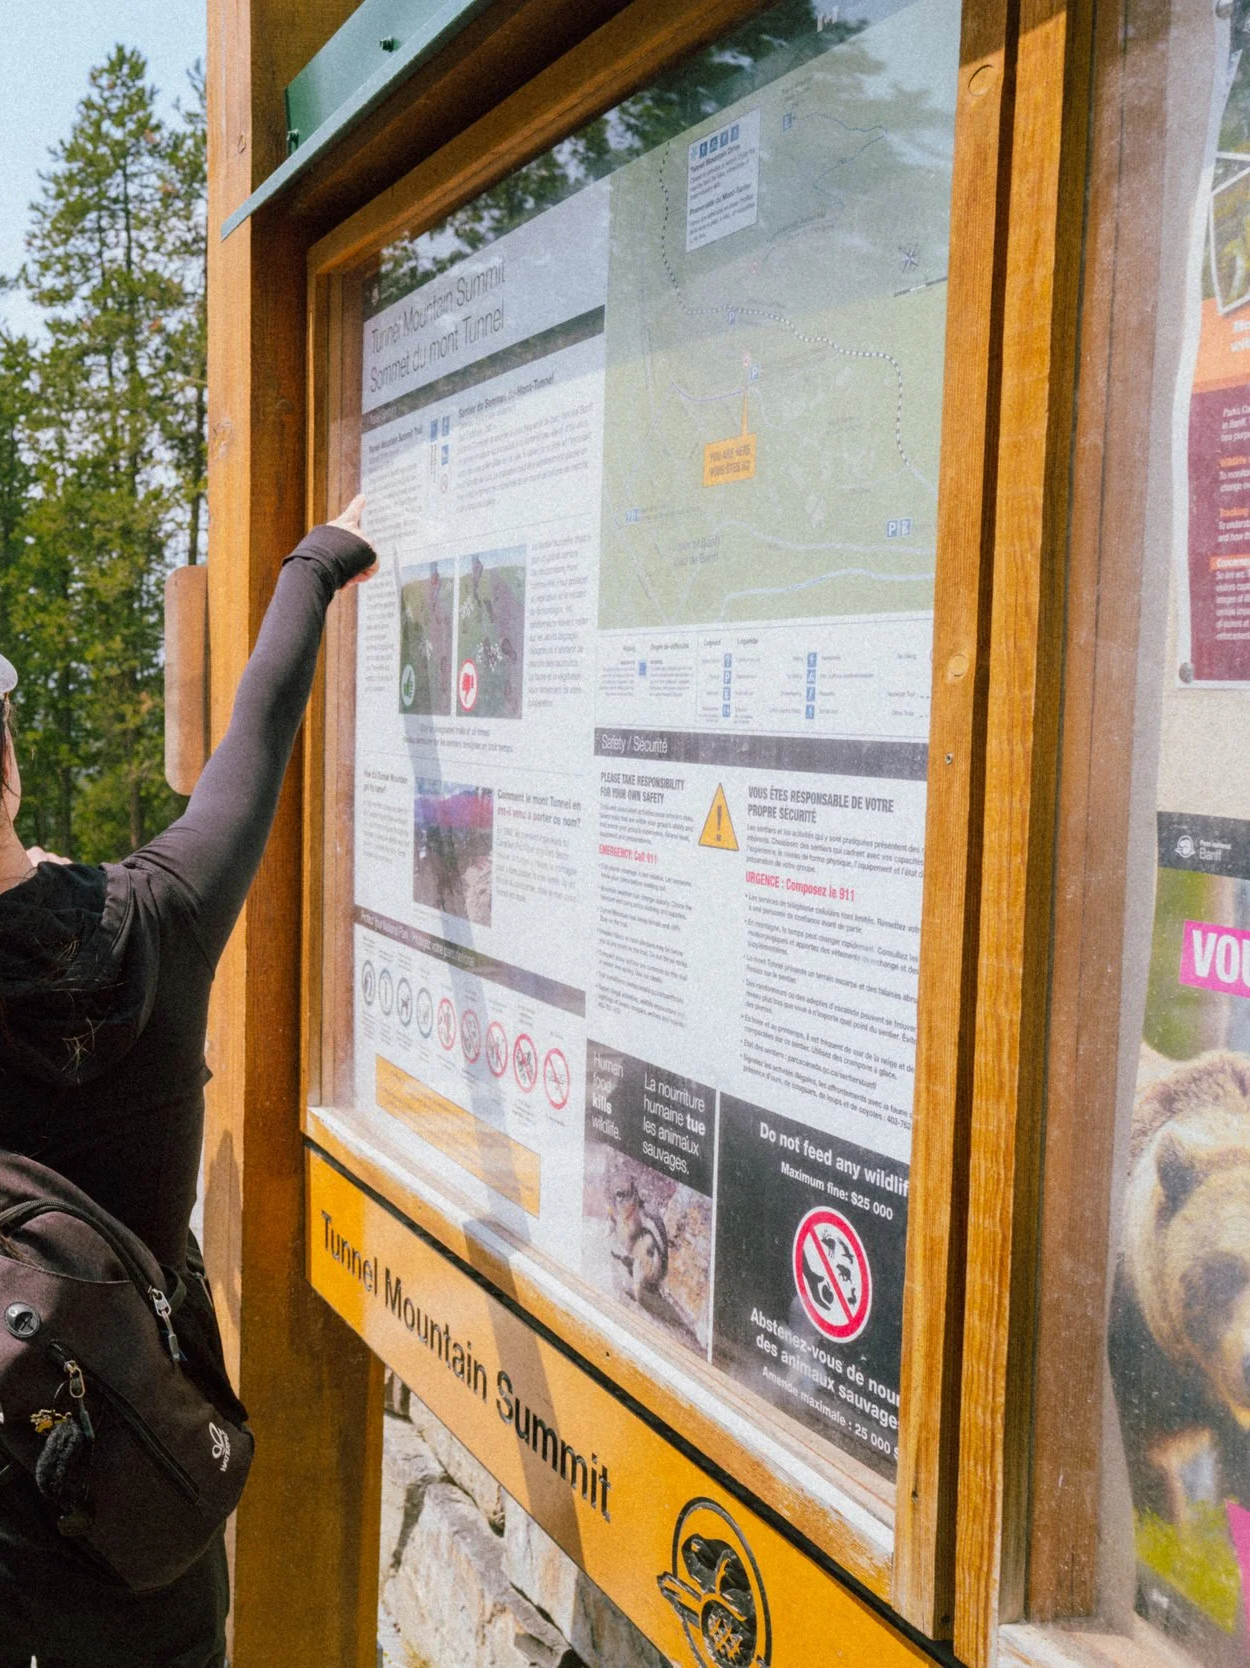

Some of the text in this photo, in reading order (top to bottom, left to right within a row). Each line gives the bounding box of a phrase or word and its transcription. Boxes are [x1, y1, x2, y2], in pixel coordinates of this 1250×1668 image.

[371, 260, 505, 354] Tunnel Mountain Summit
[370, 307, 504, 393] Sommet du mont Tunnel
[601, 734, 668, 754] Safety / Sécurité
[601, 772, 684, 790] PLEASE TAKE RESPONSIBILITY
[498, 789, 581, 811] Comment le mont Tunnel en
[600, 787, 664, 804] FOR YOUR OWN SAFETY
[749, 787, 894, 812] VOUS ÊTES RESPONSABLE DE VOTRE
[533, 812, 551, 823] porter
[553, 816, 561, 825] ce
[563, 817, 581, 828] nom?
[748, 804, 816, 823] PROPRE SÉCURITÉ
[634, 850, 645, 862] Call
[647, 853, 657, 864] 911
[874, 839, 920, 853] présentent des
[1200, 847, 1222, 861] Banff
[746, 872, 779, 888] URGENCE
[786, 878, 826, 898] Composez
[830, 886, 837, 898] le
[839, 887, 855, 901] 911
[877, 918, 906, 930] Remettez
[877, 945, 908, 959] Consultez
[860, 1010, 884, 1025] peuvent
[869, 1024, 877, 1034] du
[593, 1052, 623, 1078] Human
[879, 1067, 897, 1081] glace.
[593, 1074, 615, 1095] food
[644, 1073, 705, 1112] La nourriture
[592, 1092, 612, 1114] kills
[592, 1114, 621, 1141] wildlife.
[643, 1097, 706, 1136] humaine tue
[643, 1116, 699, 1157] les animaux
[642, 1140, 690, 1175] sauvages.
[760, 1121, 776, 1144] Do
[779, 1132, 800, 1153] not
[803, 1140, 832, 1165] feed
[836, 1158, 859, 1180] any
[781, 1161, 893, 1220] Maximum fine: $25 000
[750, 1308, 843, 1374] Abstenez-vous
[846, 1364, 864, 1385] de
[321, 1210, 613, 1523] Tunnel Mountain Summit
[756, 1334, 778, 1357] des
[781, 1350, 835, 1392] animaux
[763, 1366, 798, 1396] Amende
[800, 1392, 846, 1426] maximale
[855, 1424, 867, 1440] 25
[870, 1434, 890, 1454] 000
